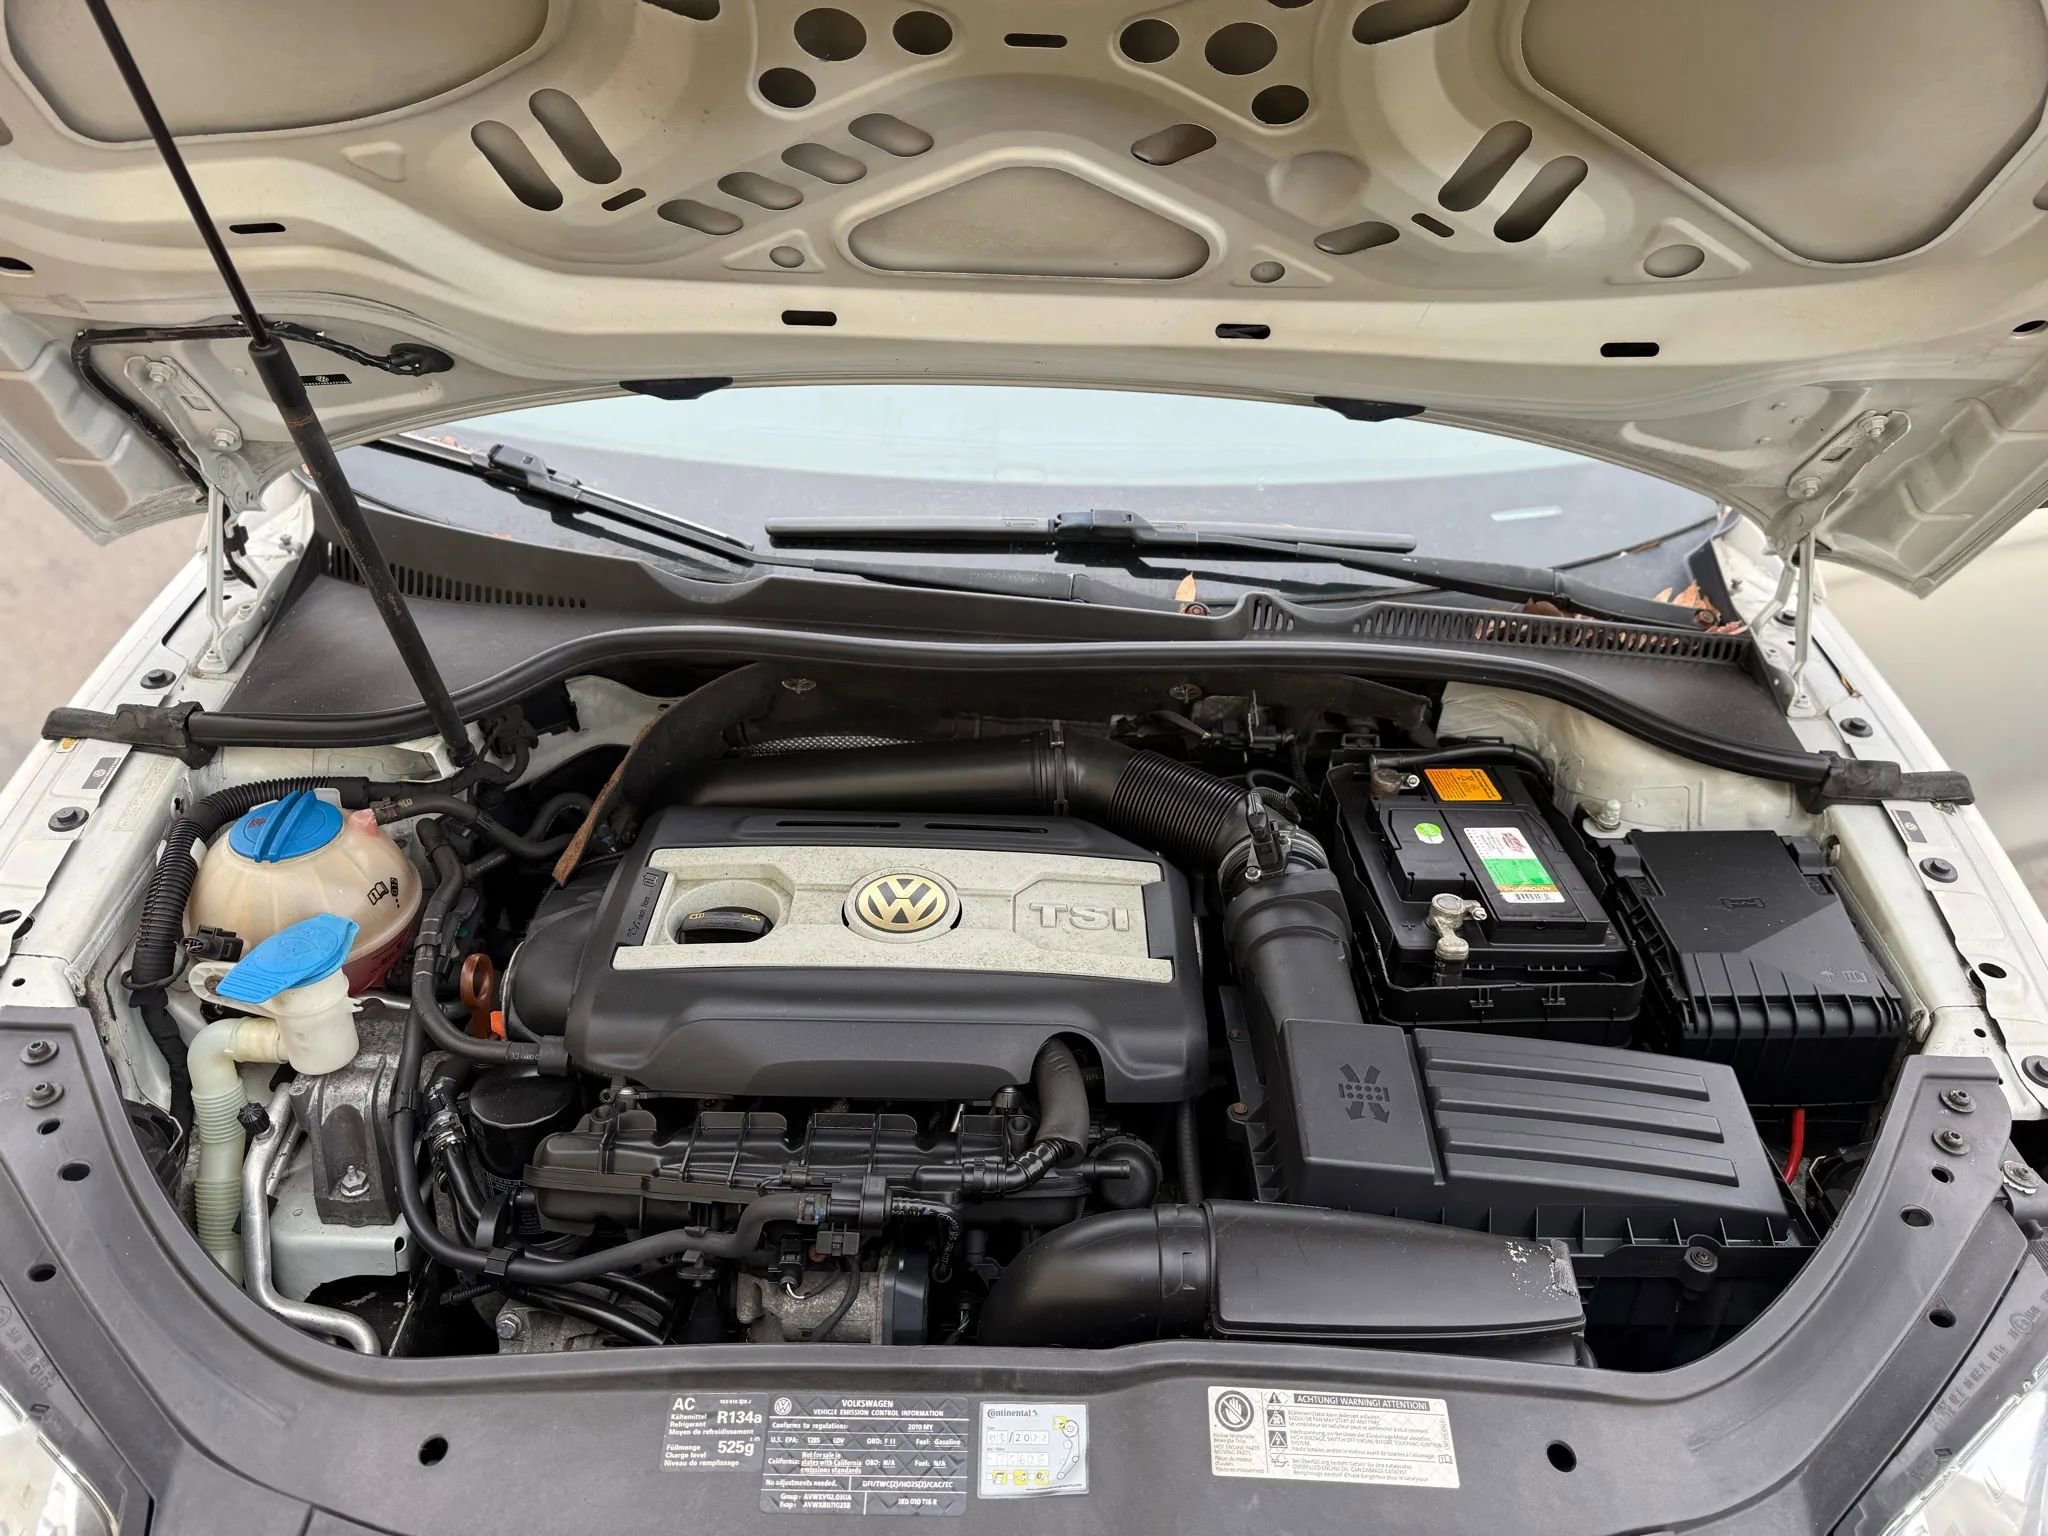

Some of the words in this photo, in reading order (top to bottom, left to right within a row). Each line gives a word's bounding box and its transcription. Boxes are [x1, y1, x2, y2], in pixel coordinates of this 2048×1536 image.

[1029, 902, 1130, 931] TSI
[672, 1397, 696, 1411] AC
[841, 1399, 894, 1408] VOLKSWAGEN
[1297, 1395, 1338, 1405] ACHTUNG!
[1340, 1397, 1381, 1407] WARNING!
[1382, 1399, 1428, 1410] ATTENTION!
[717, 1410, 762, 1424] R134a
[987, 1408, 1031, 1418] Continental
[772, 1421, 801, 1429] Conforms
[933, 1438, 961, 1446] Gasoline
[717, 1440, 755, 1456] 525g
[665, 1451, 689, 1459] Charge
[699, 1459, 739, 1467] remplissage
[833, 1459, 862, 1467] California
[775, 1479, 812, 1487] adjustments
